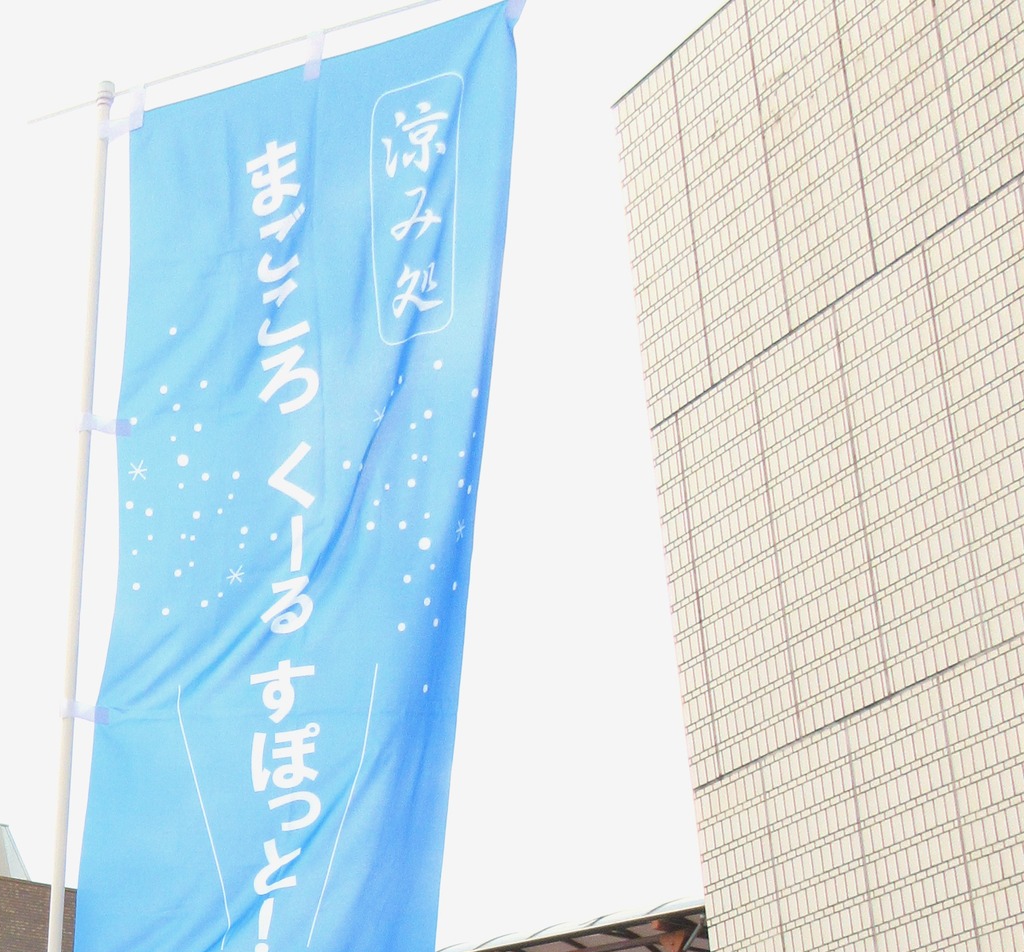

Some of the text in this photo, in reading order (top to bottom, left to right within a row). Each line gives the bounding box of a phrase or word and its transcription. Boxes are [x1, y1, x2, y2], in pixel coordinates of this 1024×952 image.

[246, 140, 319, 415] まごころ
[381, 102, 446, 319] 涼み処
[260, 441, 315, 634] くーる
